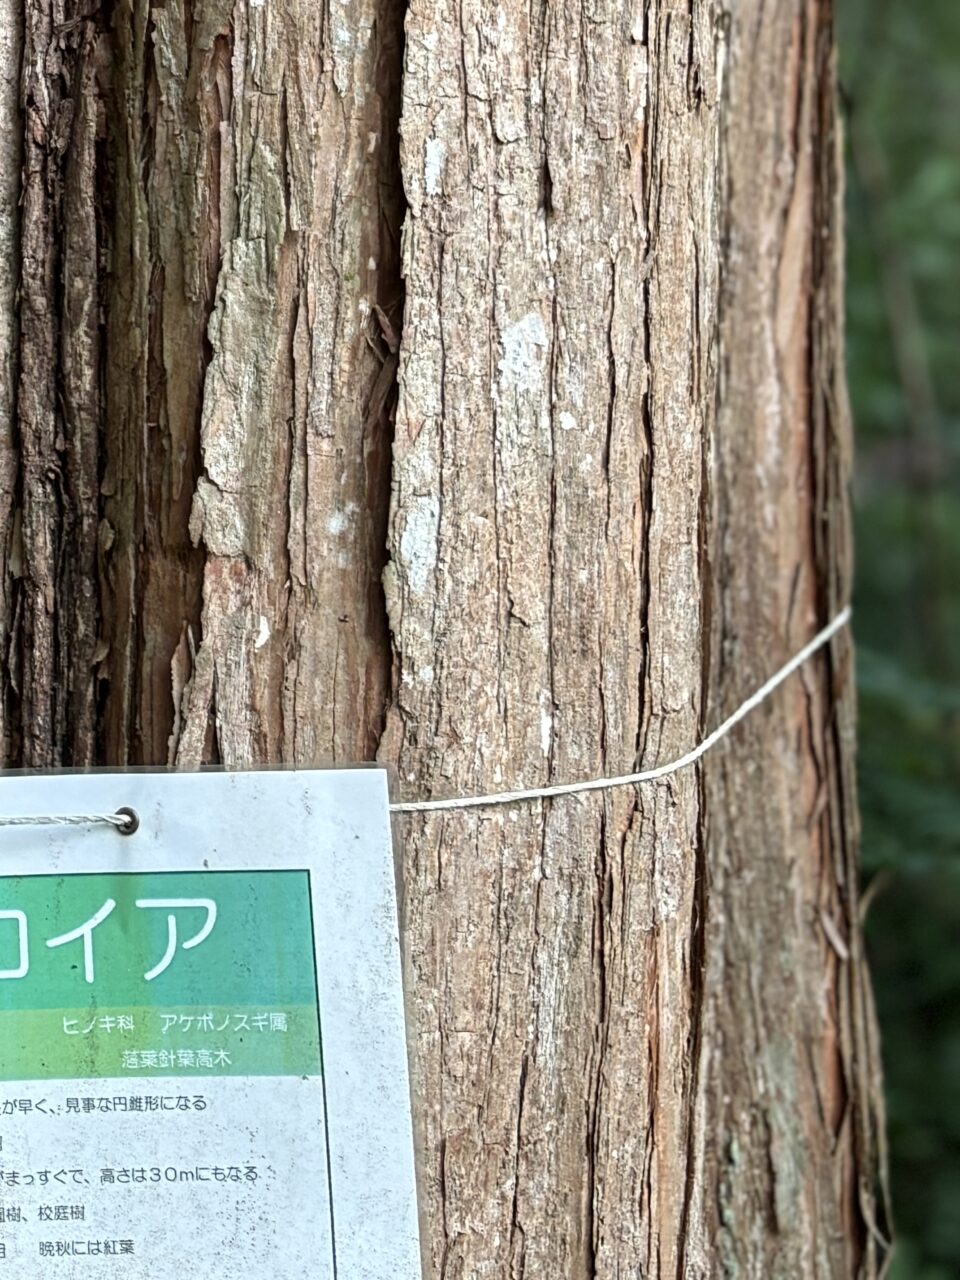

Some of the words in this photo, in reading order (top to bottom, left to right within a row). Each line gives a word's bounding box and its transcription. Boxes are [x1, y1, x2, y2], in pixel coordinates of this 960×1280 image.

[62, 1016, 135, 1035] ヒノキ科
[160, 1012, 288, 1033] アケボノスギ属
[121, 1049, 232, 1069] 落葉針葉高木
[38, 1239, 135, 1257] 晩秋には紅葉
